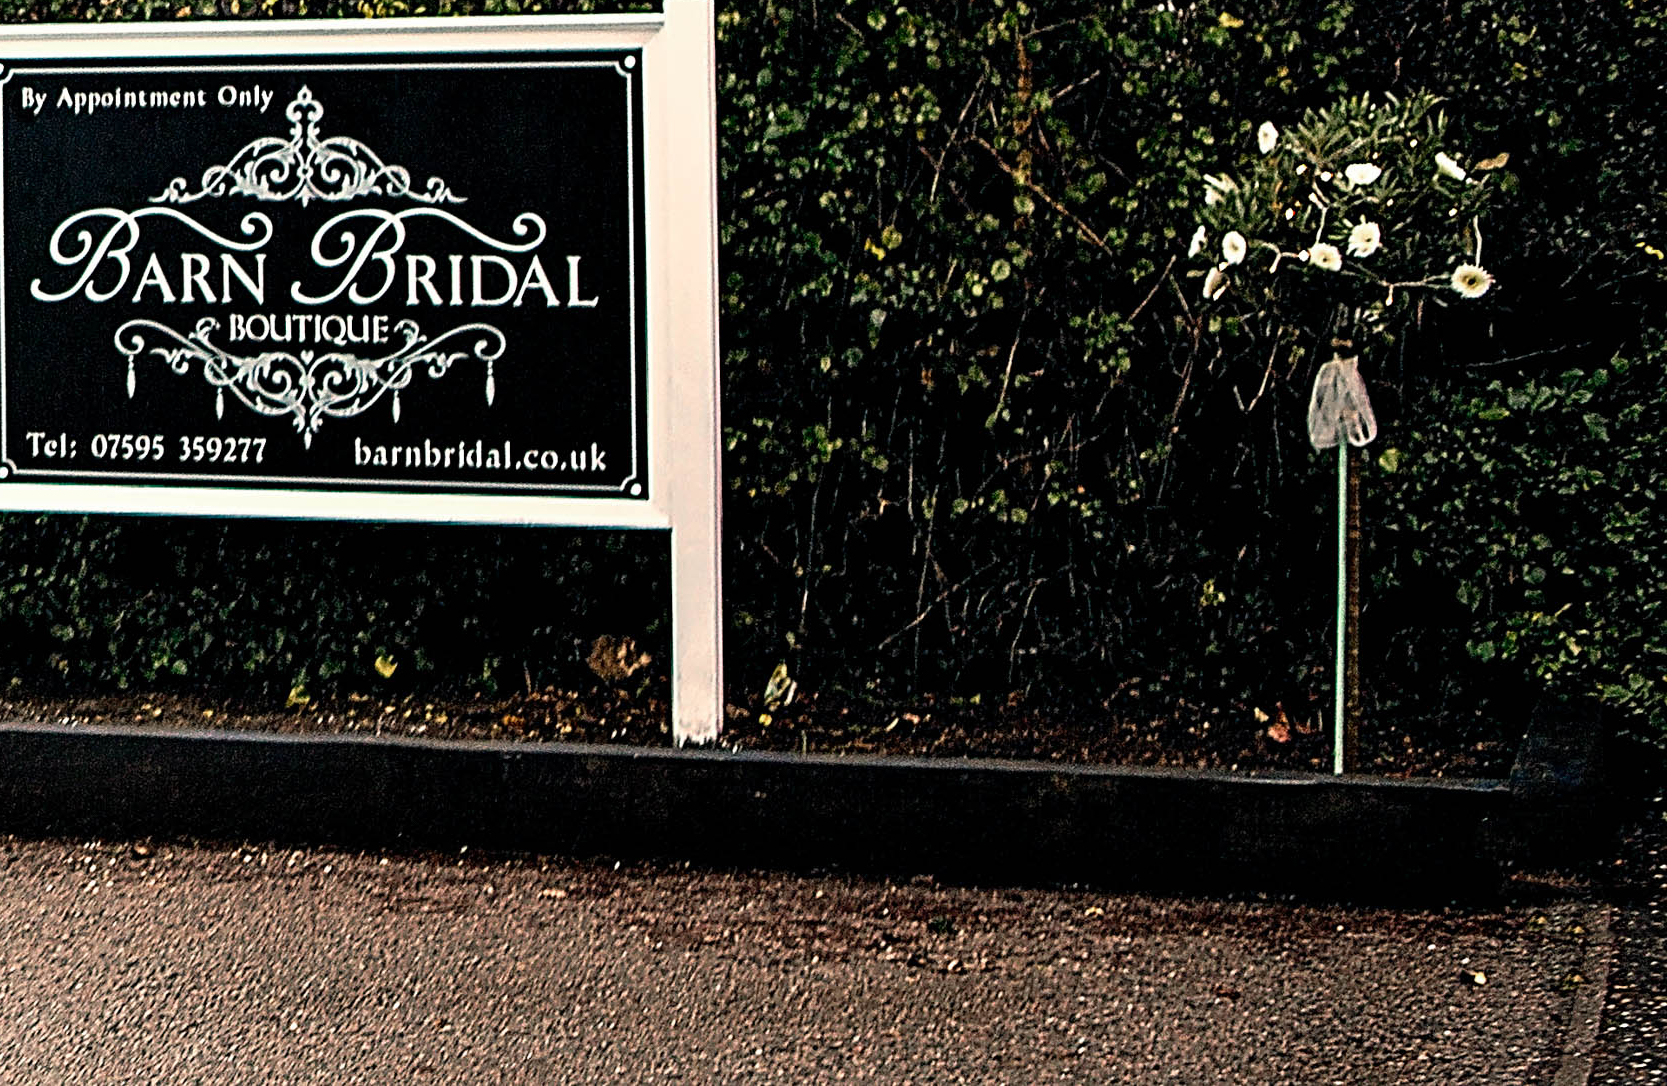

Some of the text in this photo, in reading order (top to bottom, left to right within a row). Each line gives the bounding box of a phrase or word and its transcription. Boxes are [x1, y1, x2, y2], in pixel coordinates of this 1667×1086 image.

[21, 84, 274, 116] By Appointment Only
[30, 206, 599, 309] BARN BRIDAL
[228, 313, 389, 346] BOUTIQUE
[25, 431, 267, 464] Tel: 07595 359277
[354, 436, 607, 472] barnbridal.co.uk
